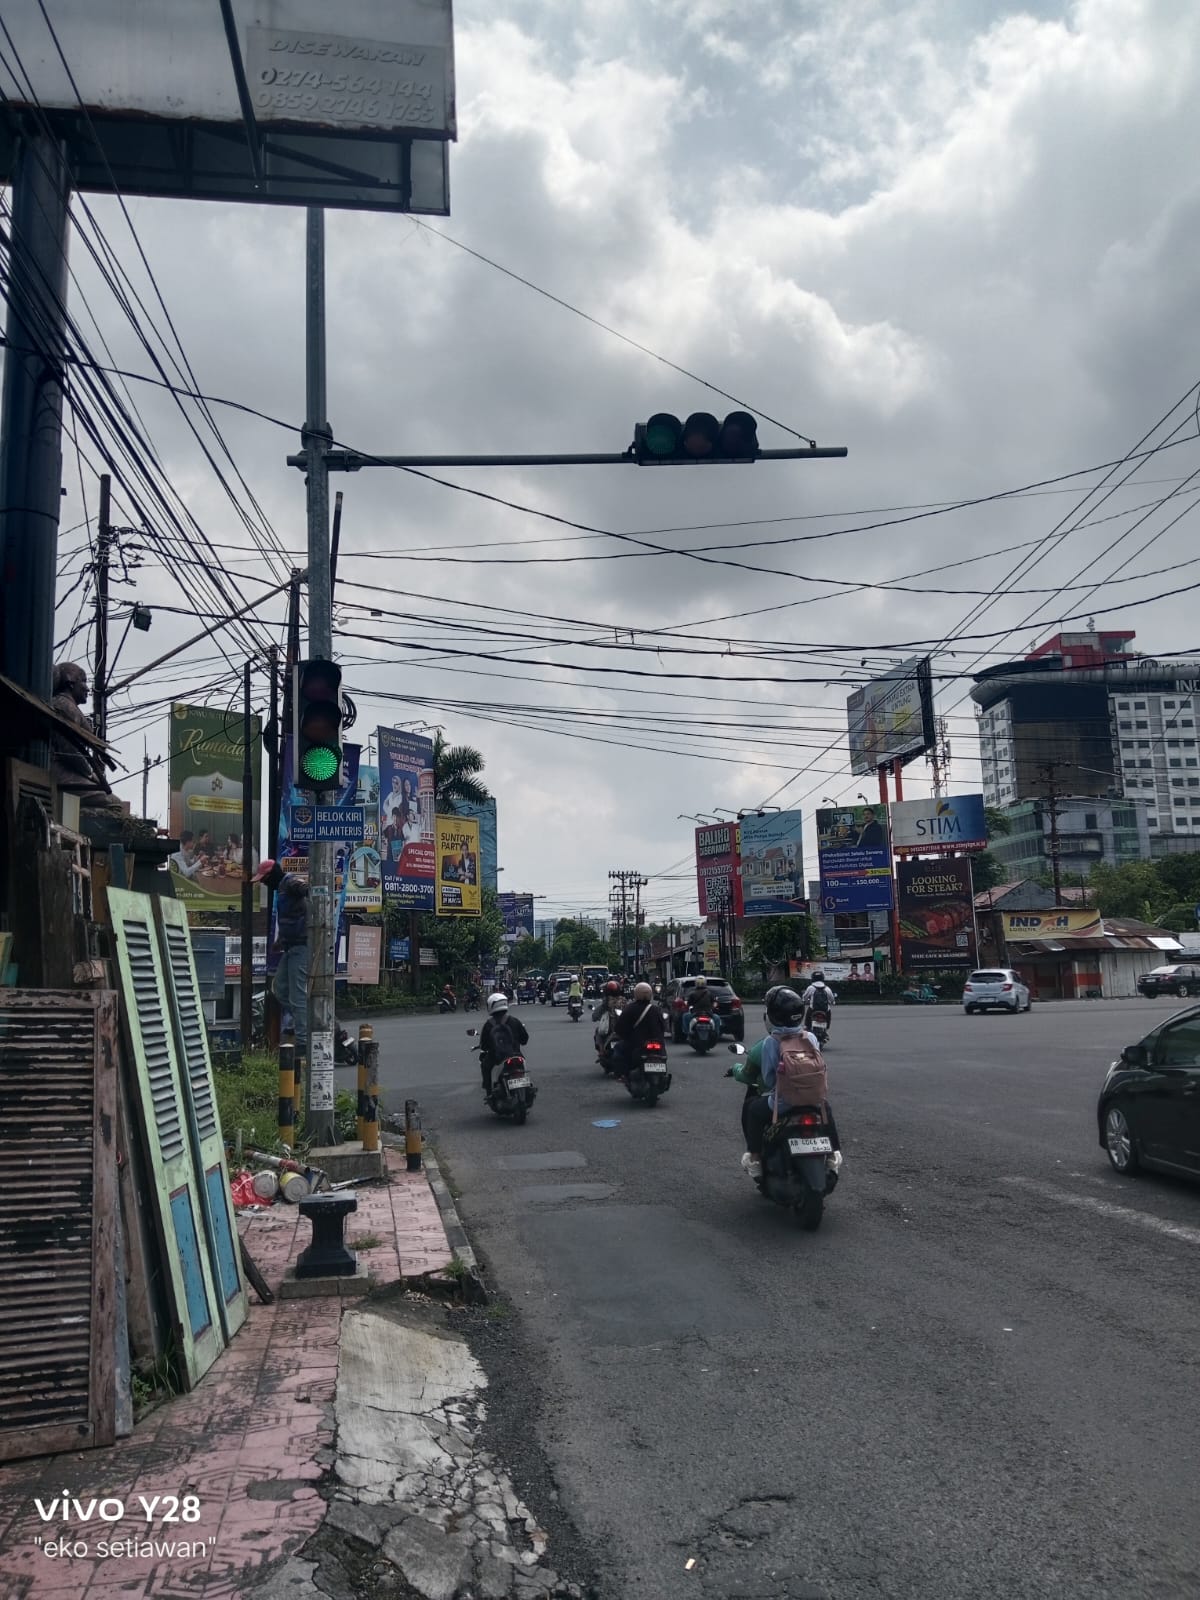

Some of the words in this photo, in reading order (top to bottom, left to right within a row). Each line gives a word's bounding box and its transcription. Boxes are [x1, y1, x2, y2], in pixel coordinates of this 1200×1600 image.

[268, 40, 425, 67] DISEWAKAN
[256, 91, 318, 113] 0859
[317, 811, 343, 822] BELOK
[346, 811, 362, 822] KIRI
[318, 826, 340, 836] JALAN
[341, 826, 362, 836] TERUS
[916, 816, 962, 836] STIM
[440, 832, 474, 844] SUNTORY
[698, 828, 730, 847] BALIHO
[911, 874, 957, 885] LOOKING
[906, 885, 925, 894] FOR
[927, 882, 963, 893] STEAK?
